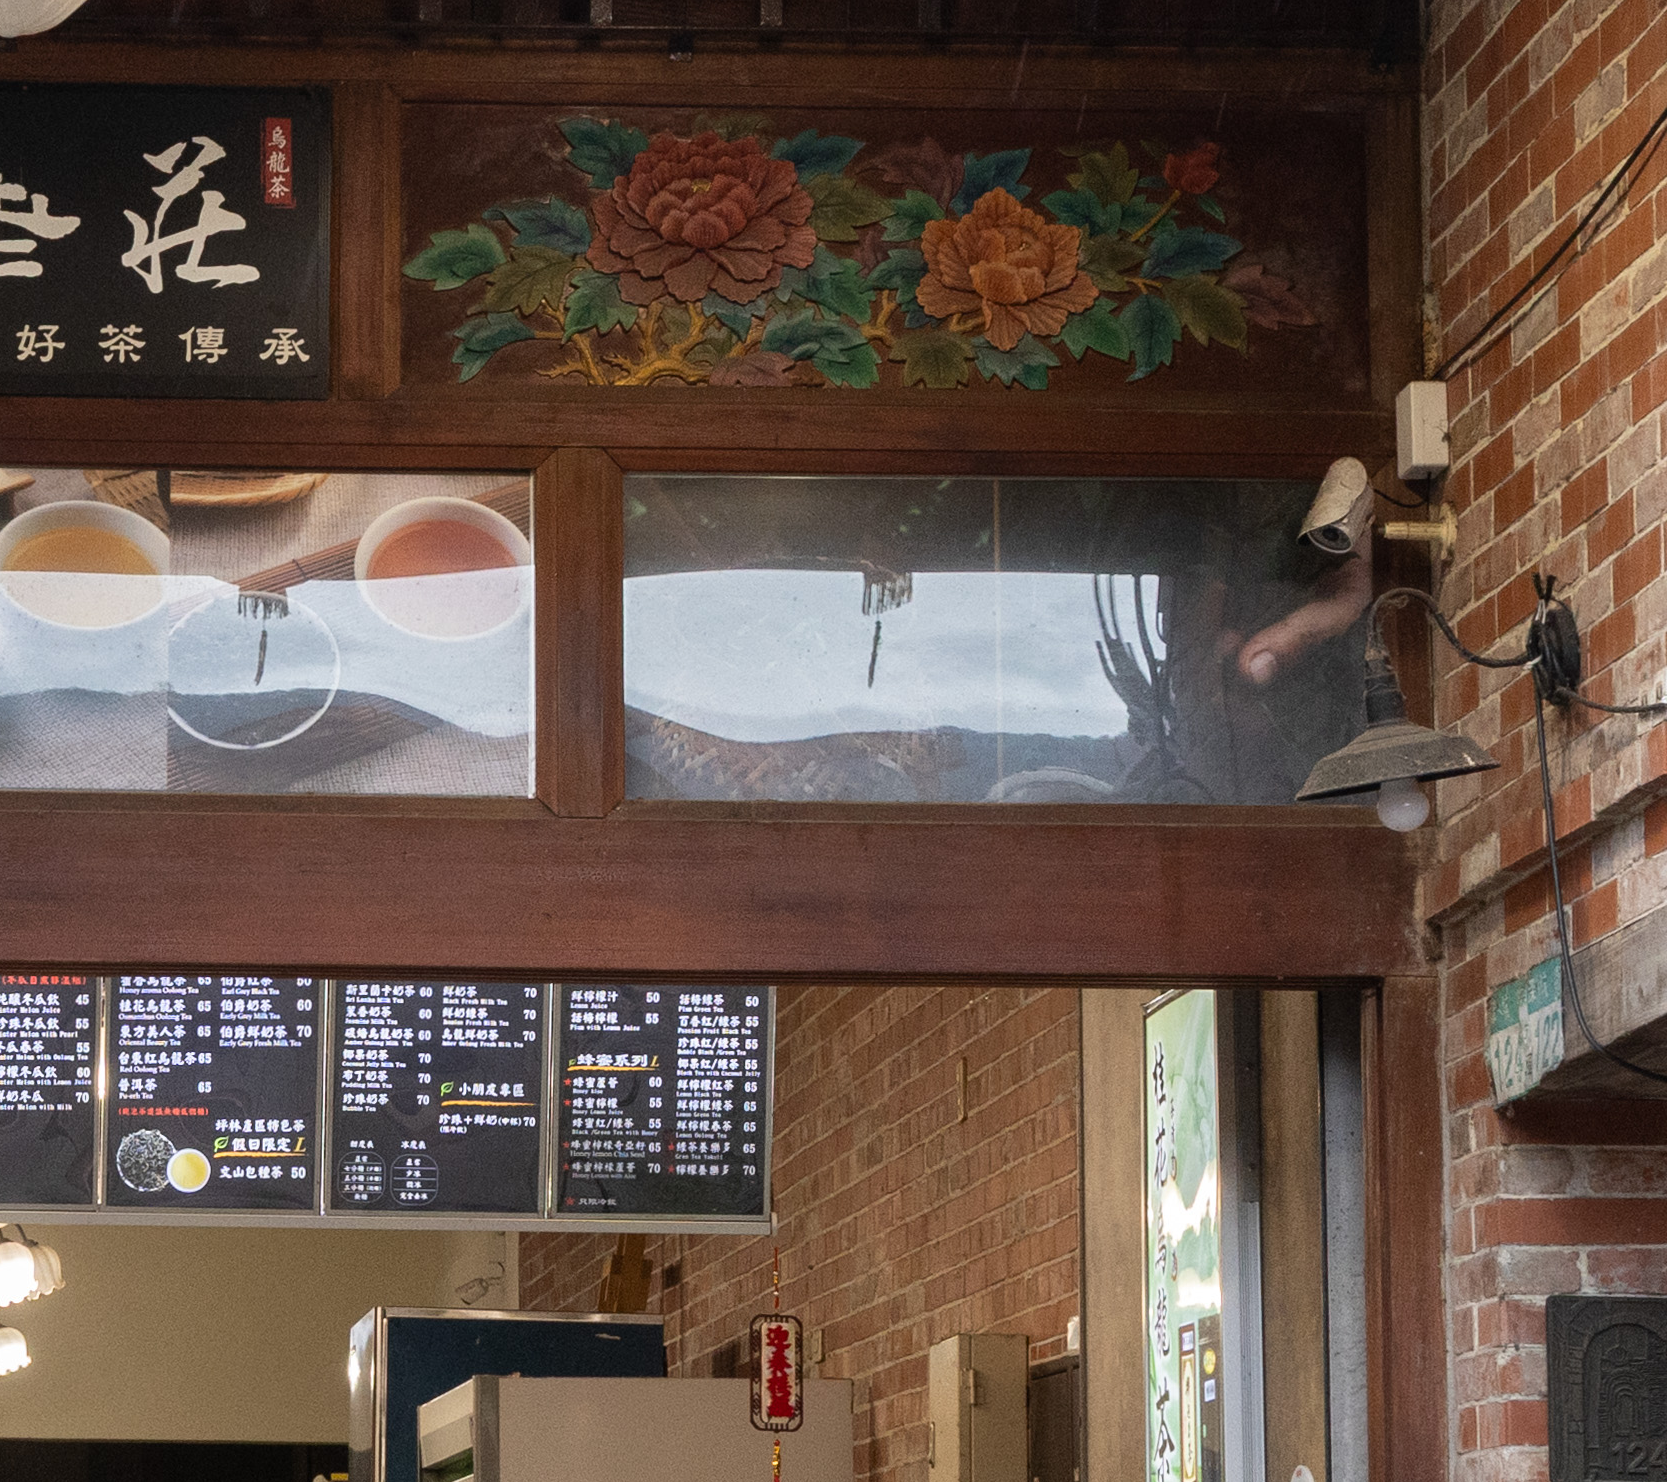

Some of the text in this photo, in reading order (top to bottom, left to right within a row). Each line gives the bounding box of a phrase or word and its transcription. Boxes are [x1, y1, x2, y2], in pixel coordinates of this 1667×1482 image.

[266, 125, 293, 203] 烏龍茶
[442, 985, 538, 998] 鮮奶茶 70
[119, 999, 212, 1013] 桂花烏龍茶 65
[220, 999, 313, 1012] 伯爵奶茶 60
[119, 1024, 212, 1039] 東方美人茶 65
[219, 1025, 313, 1039] 伯爵鮮奶茶 70
[118, 1051, 213, 1066] 台東紅烏龍茶 65
[576, 1053, 649, 1068] 蜂蜜系列
[118, 1078, 213, 1094] 普洱茶 65
[75, 1091, 90, 1104] 70
[342, 1093, 431, 1106] 珍珠奶茶 70
[231, 1137, 292, 1152] 假日限定
[219, 1165, 307, 1179] 文山包種茶 50
